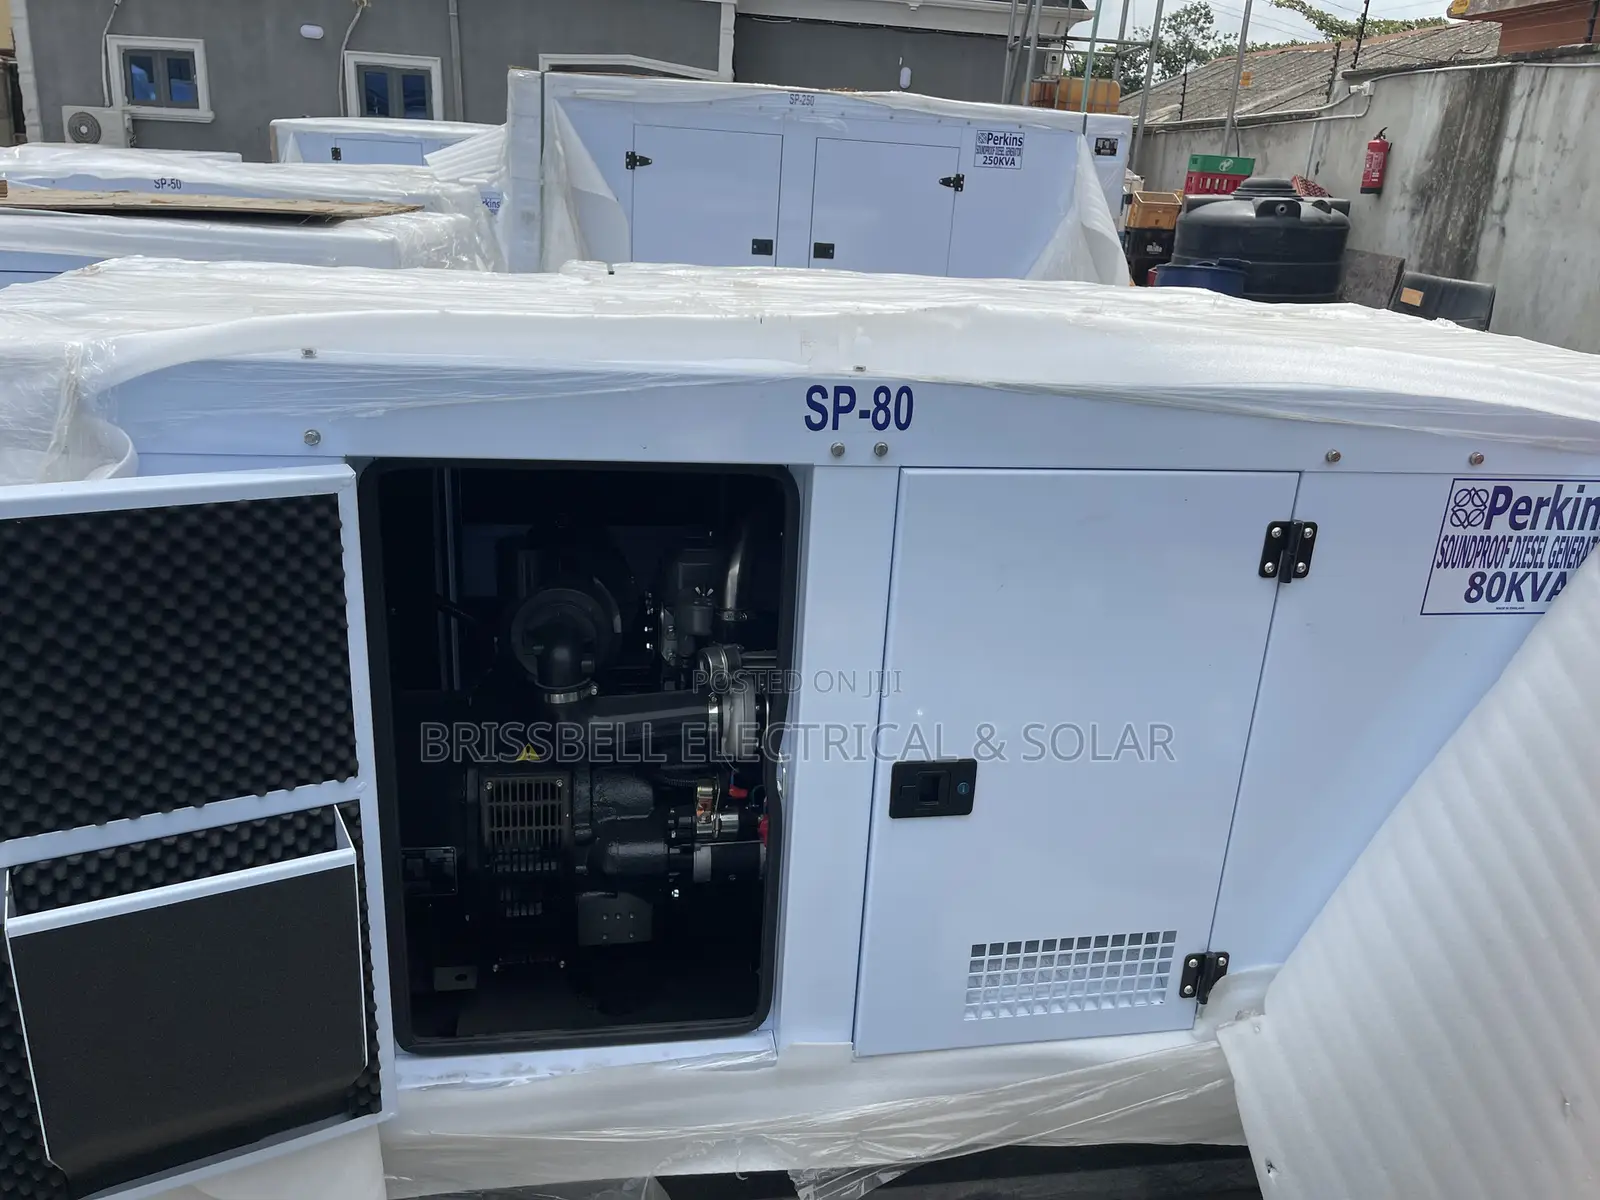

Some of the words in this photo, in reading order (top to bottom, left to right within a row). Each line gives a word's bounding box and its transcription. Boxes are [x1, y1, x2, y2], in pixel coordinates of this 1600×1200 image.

[789, 93, 815, 106] SP-250
[987, 132, 1023, 147] Perkins
[982, 155, 1016, 167] 250KVA
[153, 178, 182, 190] SP-50
[804, 384, 914, 432] SP-80
[1483, 484, 1600, 531] Perkin
[1436, 534, 1514, 569] SOUNDPROOF
[1508, 535, 1549, 569] DIESEL
[1547, 535, 1600, 569] GENERAT
[1464, 571, 1568, 604] 80KVA
